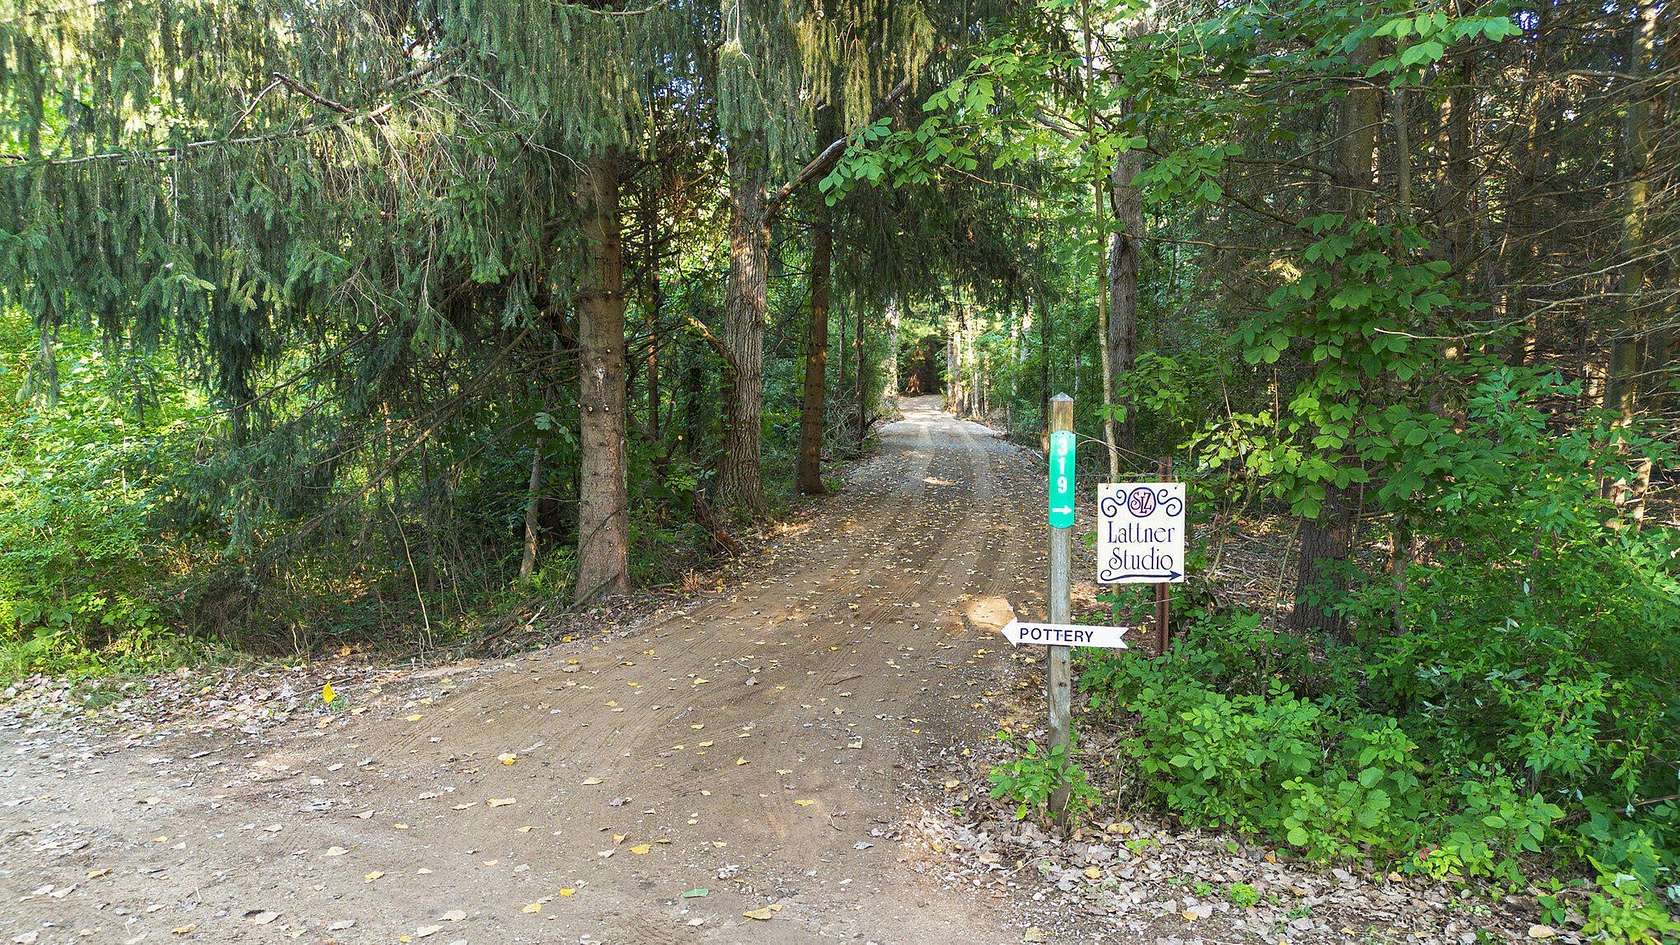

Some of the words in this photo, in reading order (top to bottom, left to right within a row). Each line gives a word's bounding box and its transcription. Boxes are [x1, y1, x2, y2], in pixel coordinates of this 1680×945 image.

[1056, 437, 1068, 494] 319
[1107, 521, 1175, 543] Lattner
[1108, 546, 1173, 570] Studio
[1020, 627, 1094, 643] POTTERY
